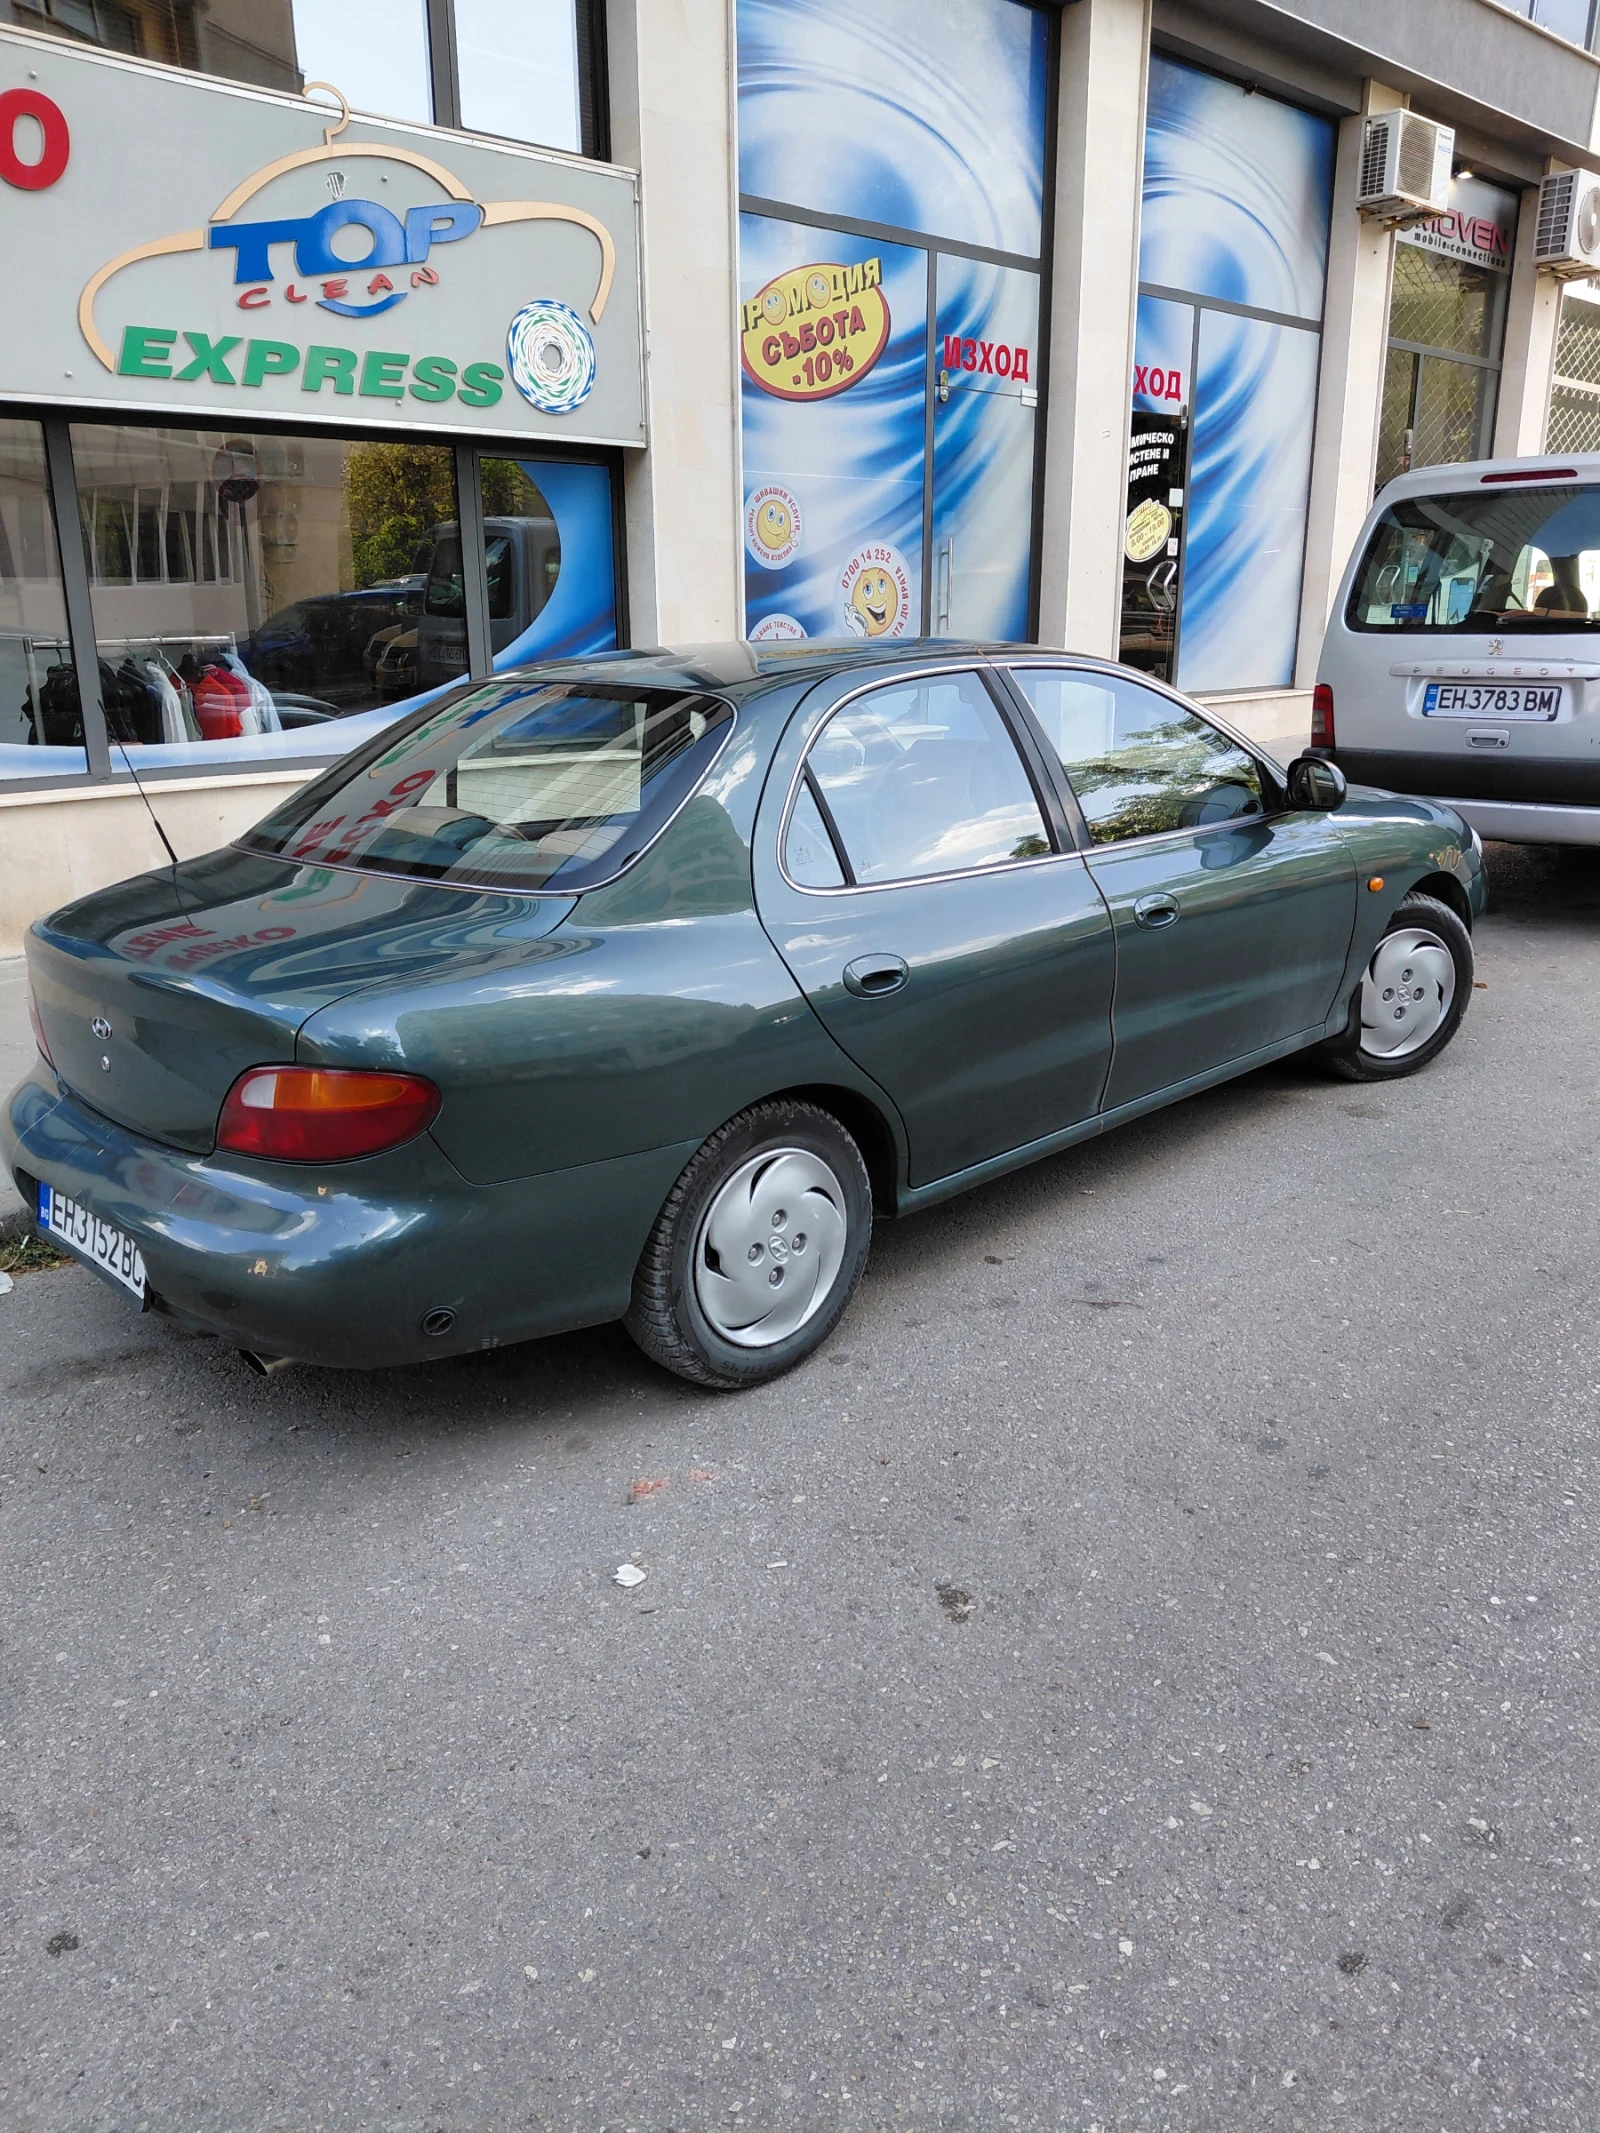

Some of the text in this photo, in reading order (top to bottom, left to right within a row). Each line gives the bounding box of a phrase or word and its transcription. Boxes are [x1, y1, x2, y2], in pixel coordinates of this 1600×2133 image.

[208, 199, 481, 285] TOP
[1414, 232, 1447, 249] mobile
[237, 266, 440, 310] CLEAN
[762, 305, 867, 365] СЪБОТА
[117, 325, 505, 409] EXPRESS
[943, 334, 1029, 383] ИЗХОД
[1162, 448, 1170, 460] И
[1129, 463, 1160, 483] ПРАНЕ
[788, 497, 801, 531] УСЛУГИ
[841, 548, 892, 589] 0700 14 252
[895, 566, 909, 600] ВРАТА
[900, 603, 909, 620] ДО
[1412, 666, 1576, 676] PEUGEOT
[40, 1206, 50, 1220] BG
